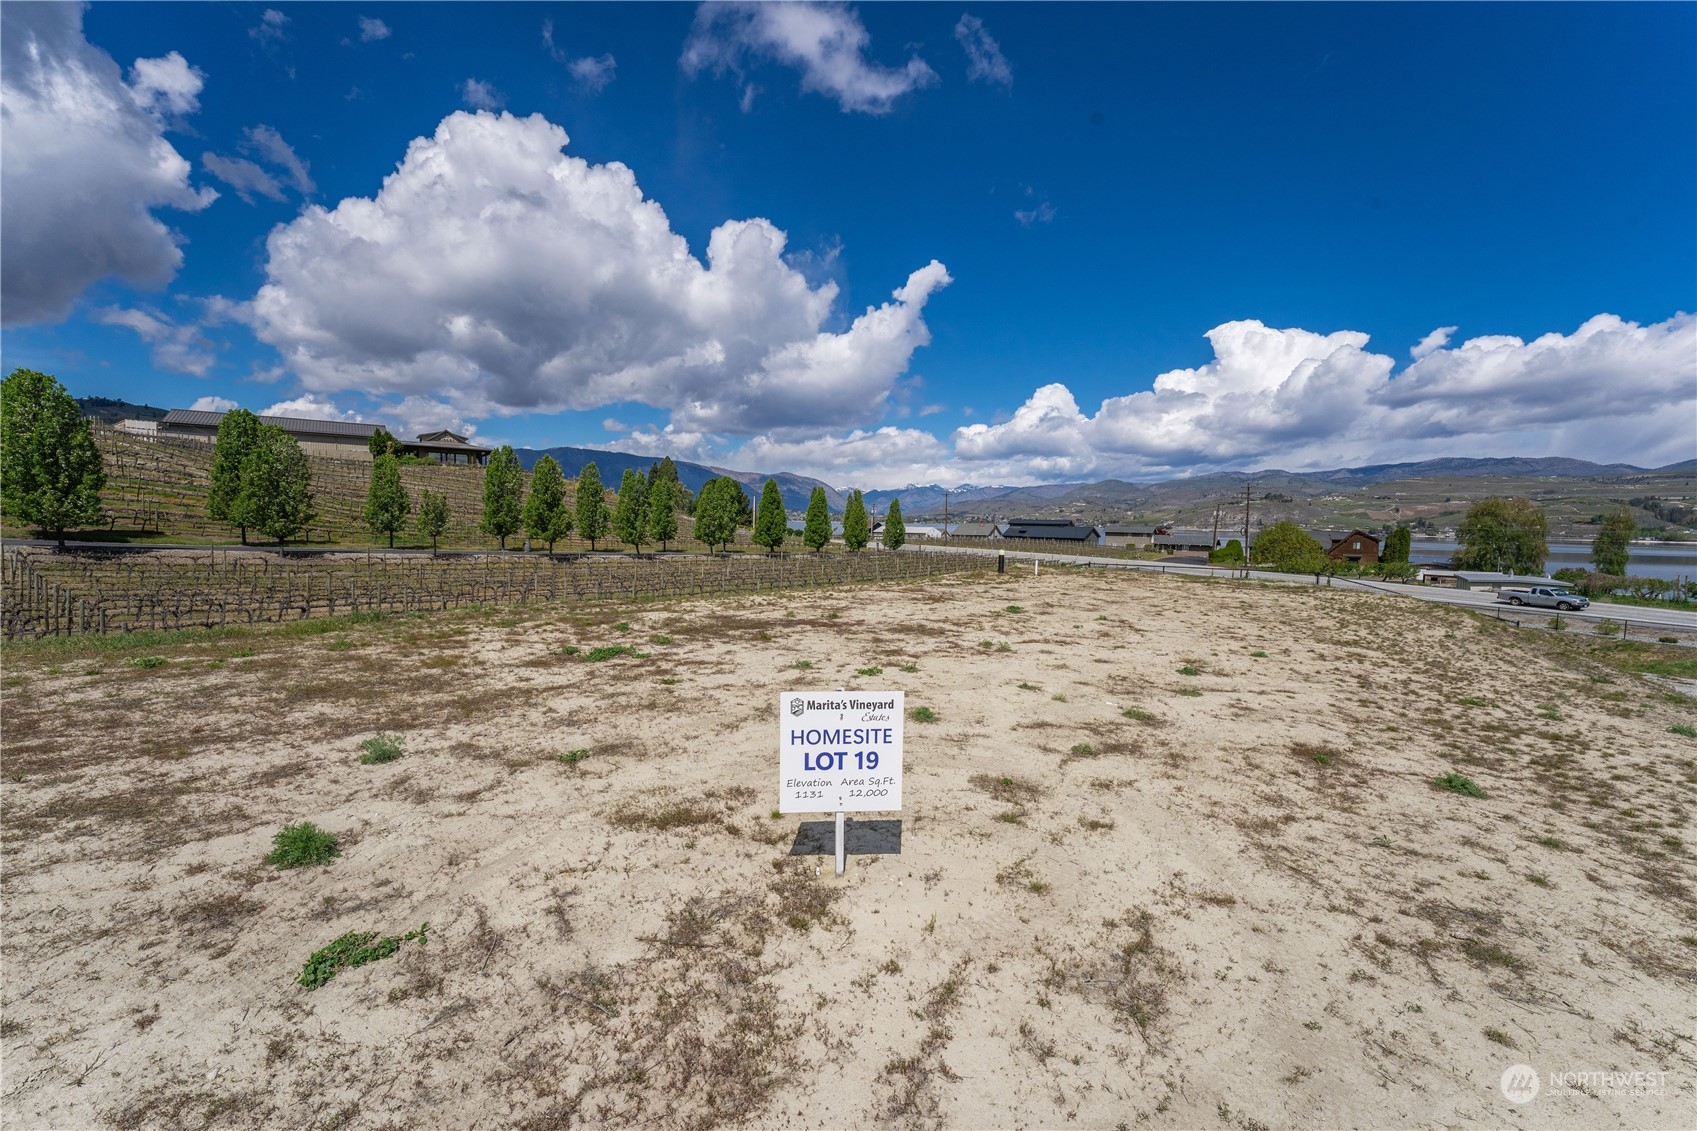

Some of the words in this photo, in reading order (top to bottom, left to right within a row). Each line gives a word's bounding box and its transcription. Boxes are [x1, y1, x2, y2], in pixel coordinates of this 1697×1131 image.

[806, 699, 848, 711] Marita's
[849, 699, 894, 712] Vineyard
[861, 712, 890, 722] Estates
[791, 728, 892, 745] HOMESITE
[804, 752, 848, 771] LOT
[854, 751, 879, 770] 19
[786, 778, 832, 788] Elevation
[840, 777, 865, 786] Area
[868, 777, 896, 788] Sq.Ft.
[795, 790, 823, 798] 1131
[849, 789, 888, 798] 12,000
